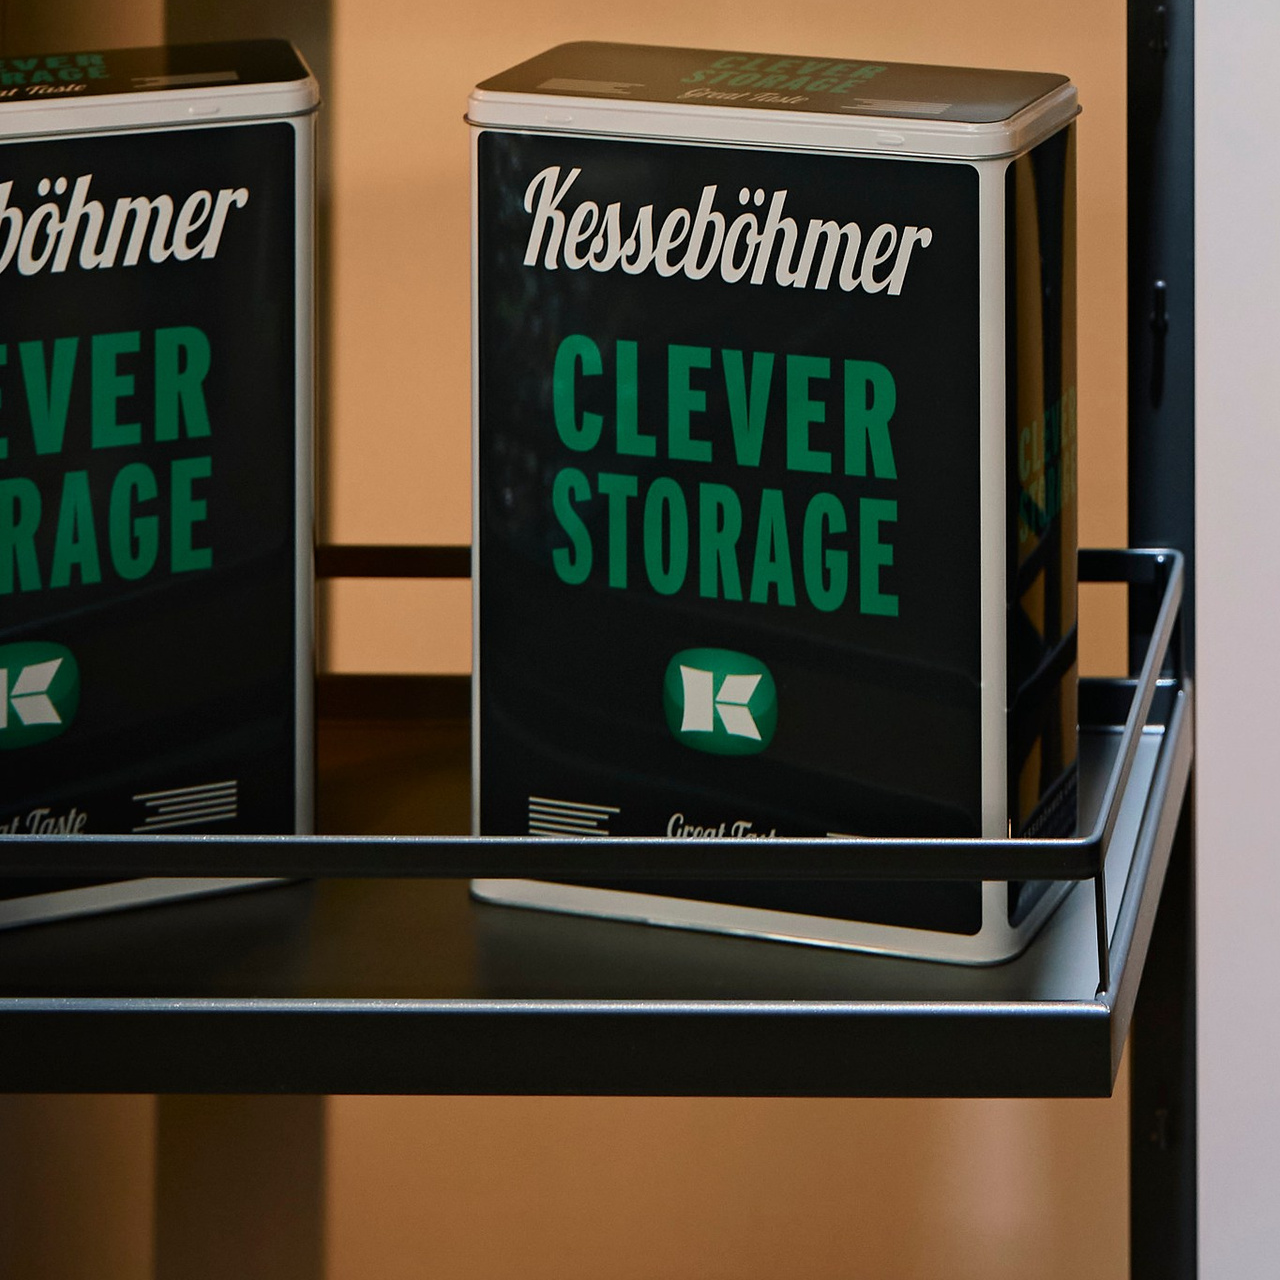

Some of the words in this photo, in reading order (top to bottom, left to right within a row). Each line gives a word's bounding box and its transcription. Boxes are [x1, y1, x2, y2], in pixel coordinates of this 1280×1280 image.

[680, 69, 866, 94] STORAGE
[710, 55, 887, 79] CLEVER
[523, 164, 932, 296] Kesseböhmer
[0, 325, 212, 459] VER
[552, 334, 898, 481] CLEVER
[551, 466, 900, 618] STORAGE
